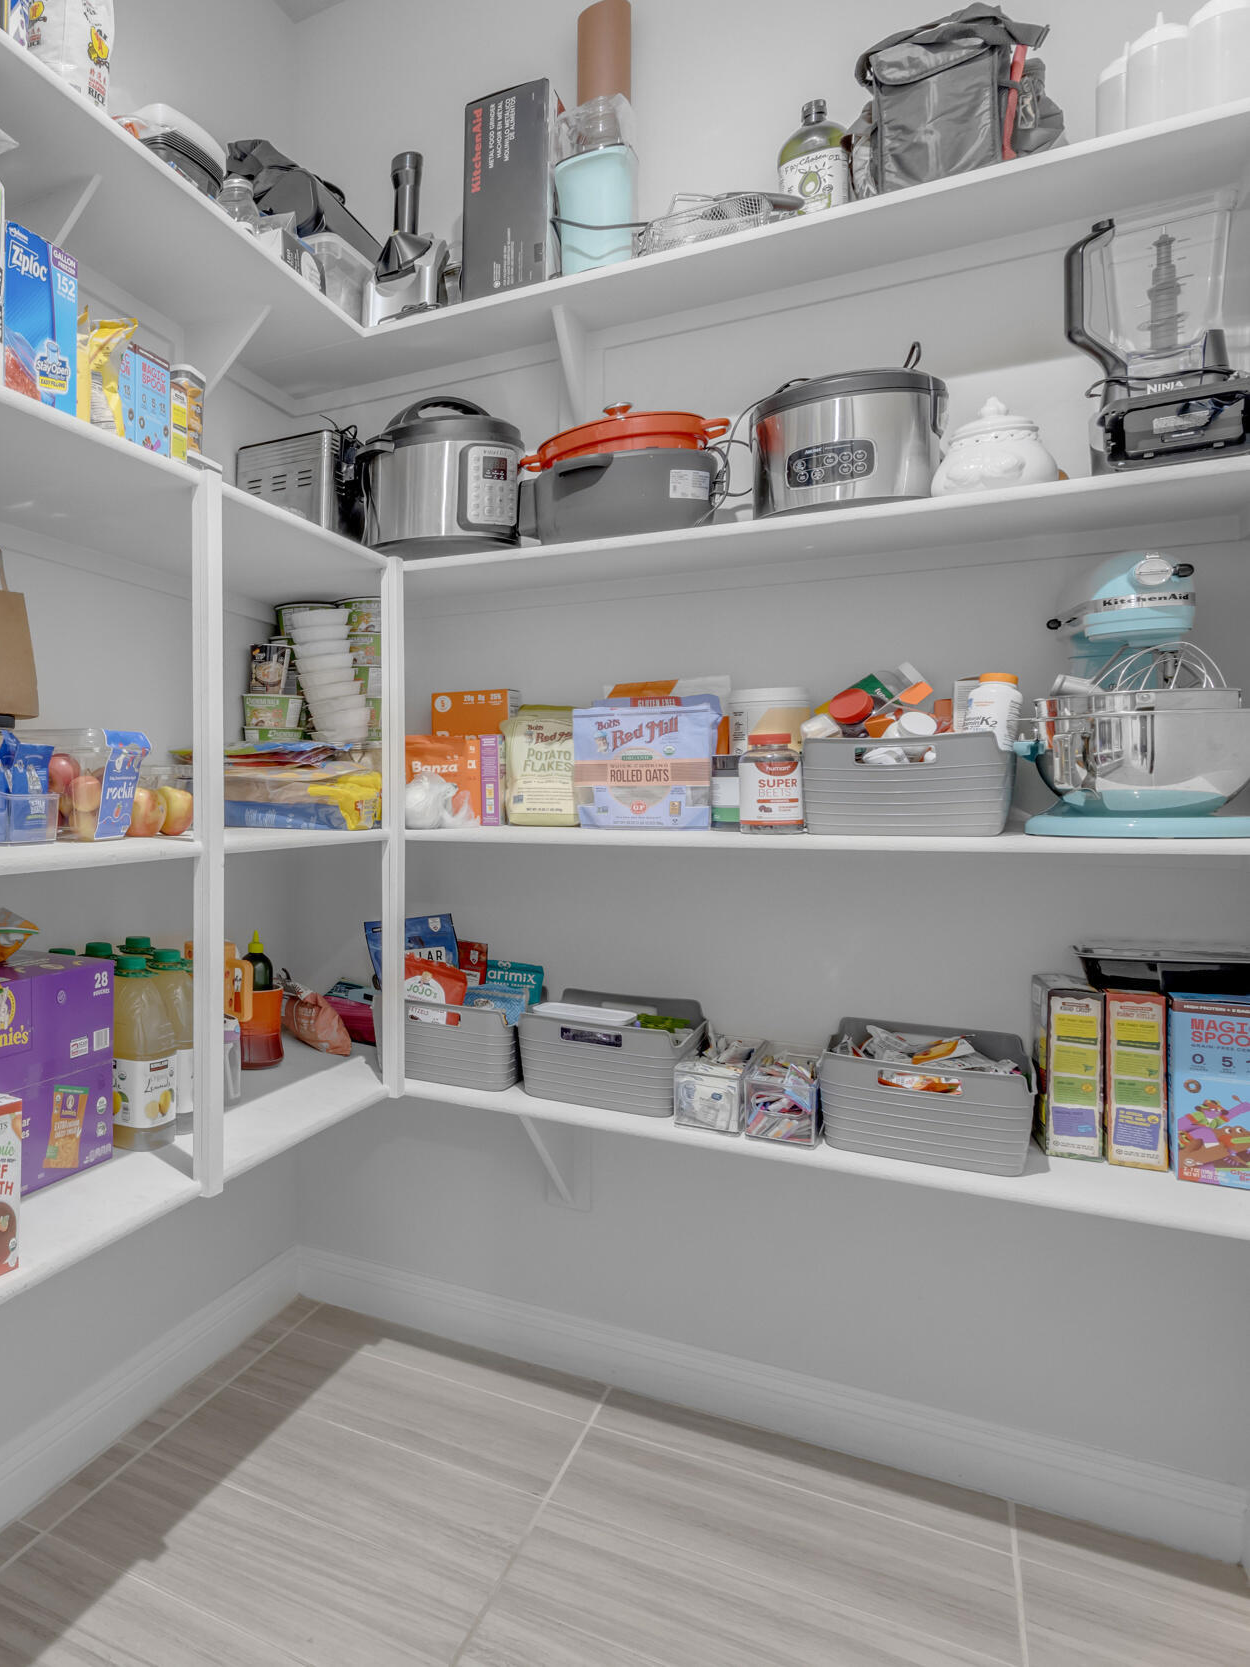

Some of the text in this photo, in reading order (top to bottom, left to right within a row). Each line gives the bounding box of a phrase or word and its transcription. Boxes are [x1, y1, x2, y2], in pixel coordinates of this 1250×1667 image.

[471, 108, 483, 193] KitchenAid
[12, 243, 48, 282] Ziploc
[53, 249, 76, 268] GALLON
[57, 273, 76, 298] 152
[36, 360, 69, 377] Stay Open
[1146, 381, 1184, 394] NINJA
[1102, 592, 1190, 607] KitchenAid
[535, 732, 556, 744] Red
[612, 716, 678, 751] Red Mill
[527, 748, 572, 760] POTATO
[412, 760, 458, 773] Banza
[523, 760, 573, 772] FLAKES
[610, 770, 670, 782] ROLLED OATS
[758, 778, 798, 788] SUPER
[106, 781, 135, 800] rockit
[758, 788, 792, 797] BEETS
[94, 971, 108, 988] 28
[488, 970, 536, 984] arimix
[1191, 1018, 1250, 1035] MAGI
[1191, 1031, 1250, 1048] SPOO
